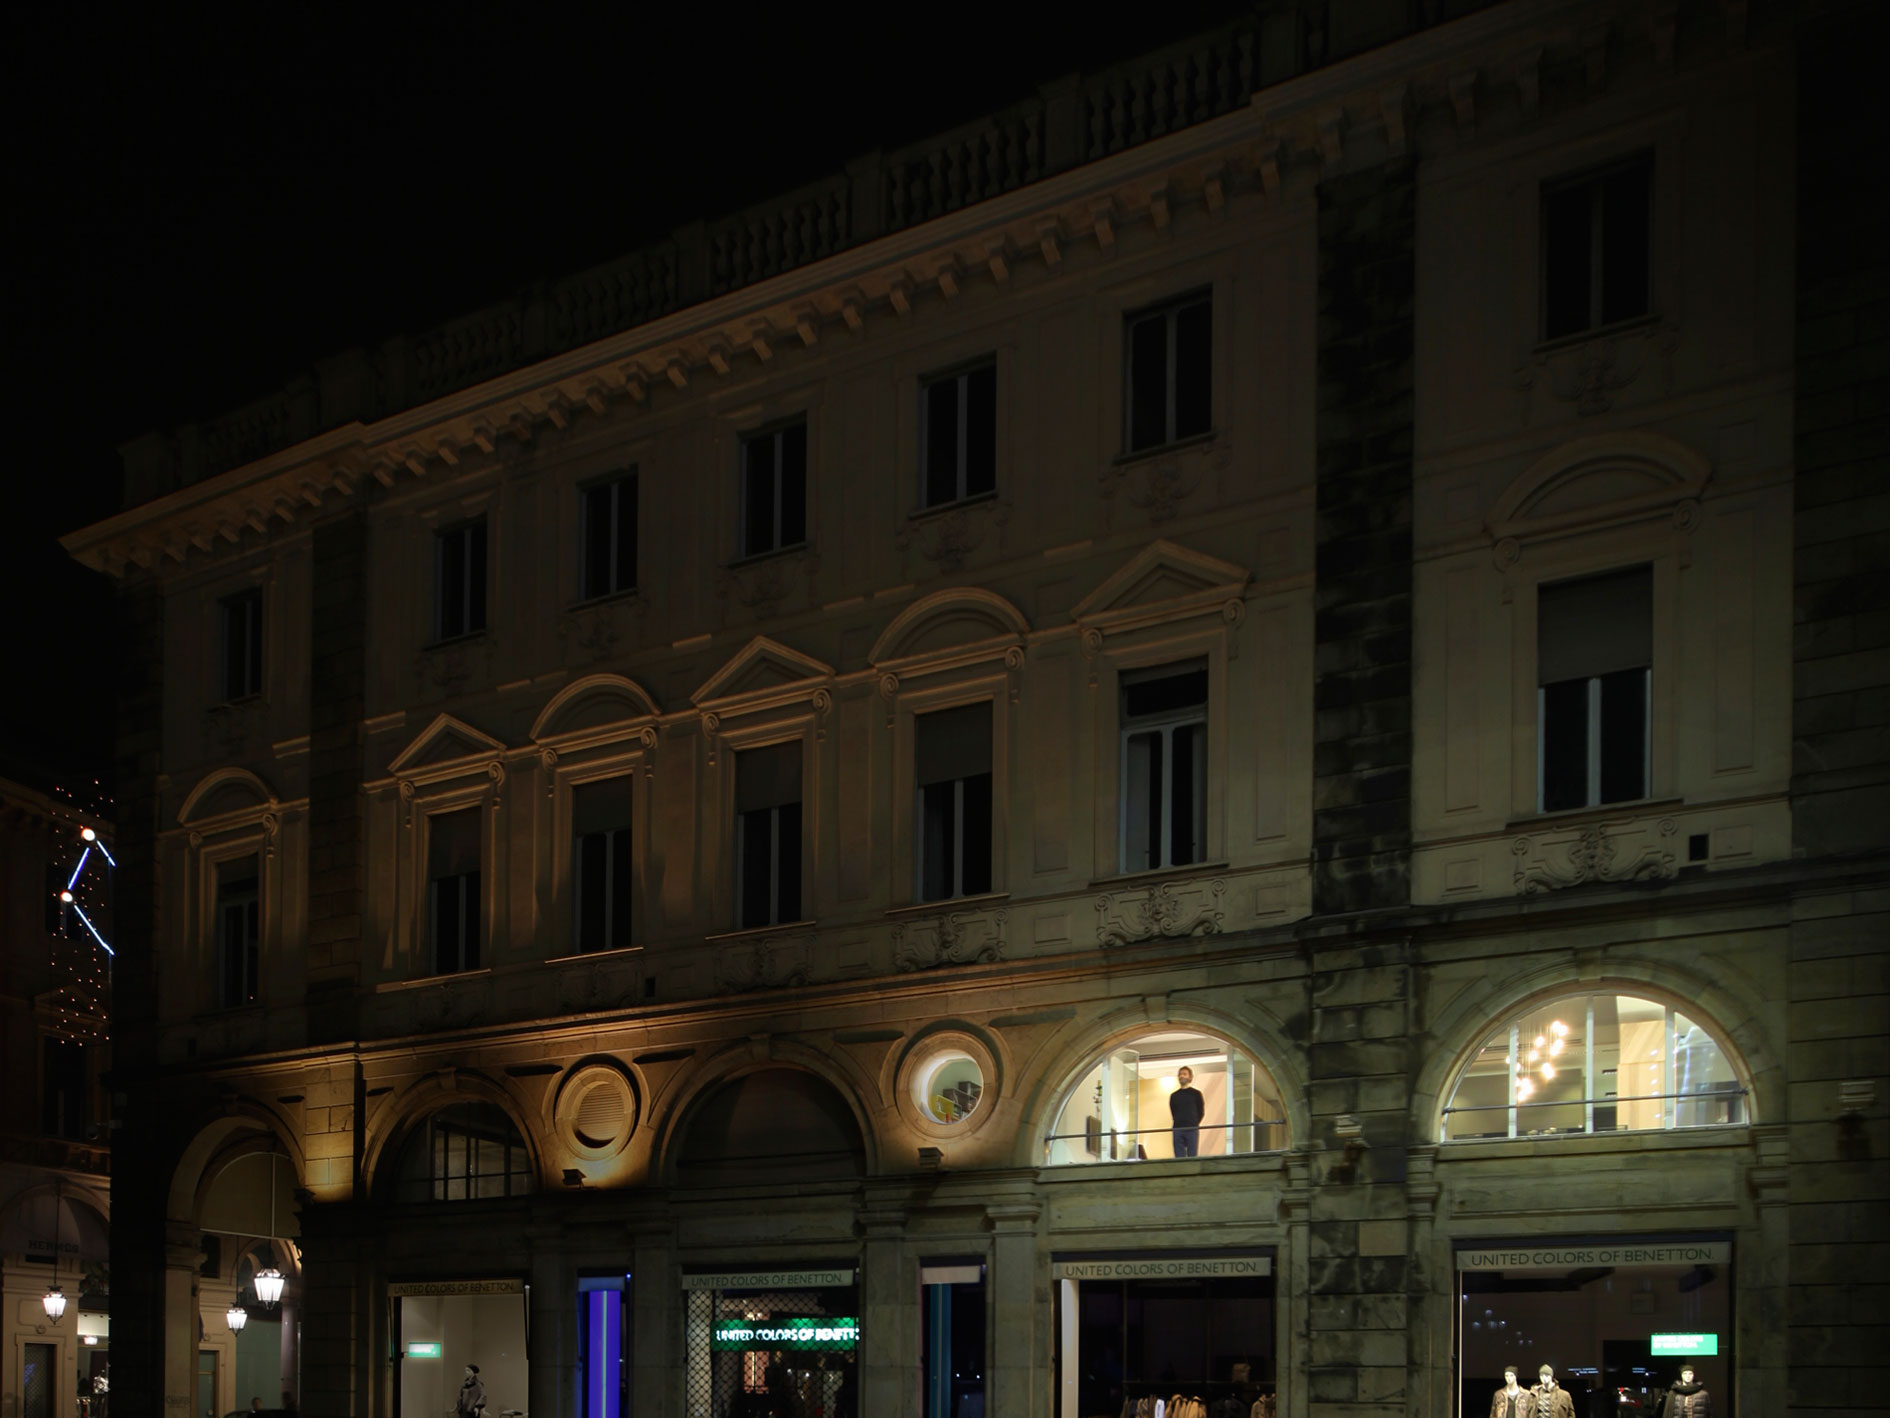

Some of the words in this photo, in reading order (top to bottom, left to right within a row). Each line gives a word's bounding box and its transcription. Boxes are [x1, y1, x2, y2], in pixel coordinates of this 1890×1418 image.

[1472, 1253, 1530, 1266] UNITED
[1533, 1251, 1594, 1265] COLORS
[1599, 1250, 1621, 1263] OF
[1066, 1264, 1112, 1276] UNITED
[1115, 1263, 1163, 1275] COLORS
[1167, 1262, 1185, 1274] OF
[691, 1276, 730, 1287] UNITED
[731, 1275, 769, 1286] COLORS
[772, 1275, 787, 1285] OF
[394, 1284, 424, 1294] UNITED
[425, 1283, 455, 1293] COLORS
[457, 1283, 468, 1293] OF
[716, 1329, 754, 1341] UNITED
[755, 1328, 798, 1341] COLORS
[798, 1328, 814, 1341] OF
